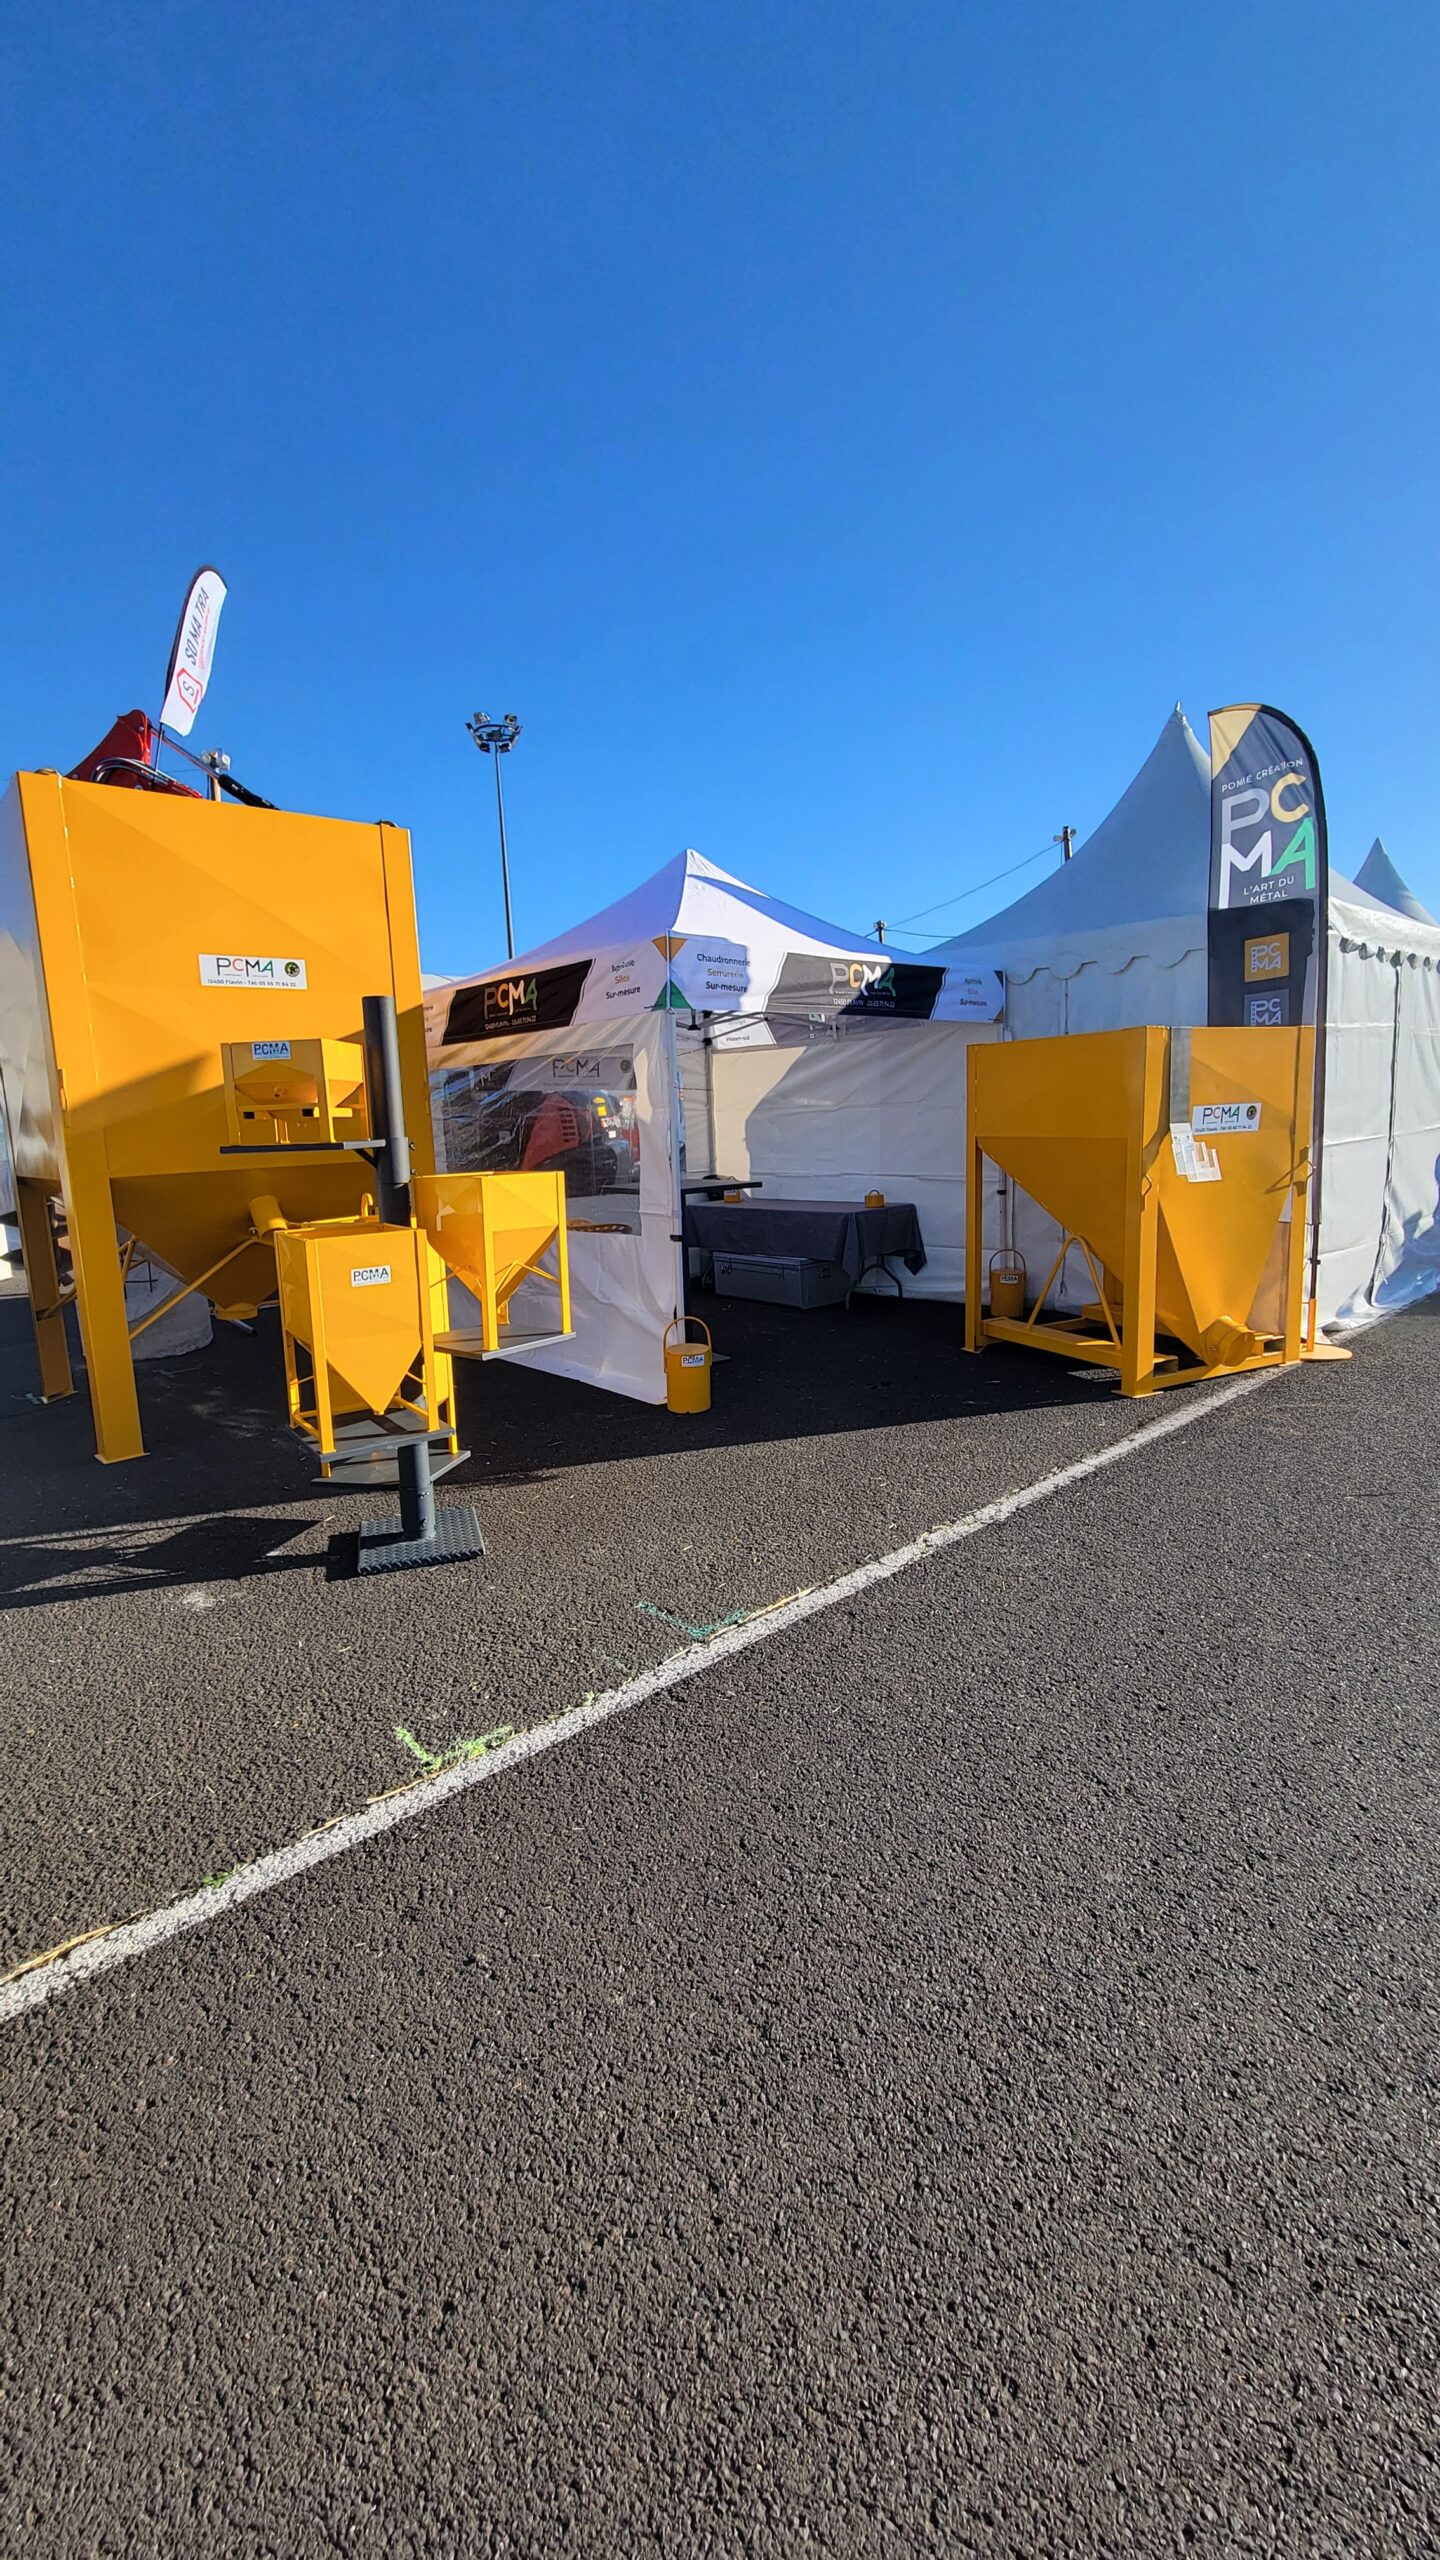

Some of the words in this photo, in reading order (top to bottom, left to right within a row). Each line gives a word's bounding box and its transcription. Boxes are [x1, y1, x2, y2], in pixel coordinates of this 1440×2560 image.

[1243, 880, 1275, 895] L'ART
[1278, 875, 1295, 887] DU
[1250, 890, 1288, 904] MÉTAL
[696, 953, 751, 967] Chaudronnerie
[216, 957, 275, 978] PCMA
[707, 968, 744, 979] Serrurerie
[829, 962, 896, 997] PCMA
[605, 986, 641, 1000] Sur-mesure
[705, 981, 749, 993] Sur-mesure
[483, 977, 538, 1019] PCMA
[253, 1042, 289, 1056] PCMA
[1202, 1105, 1240, 1125] PCMA
[353, 1267, 389, 1282] PCMA
[682, 1356, 704, 1365] PCMA
